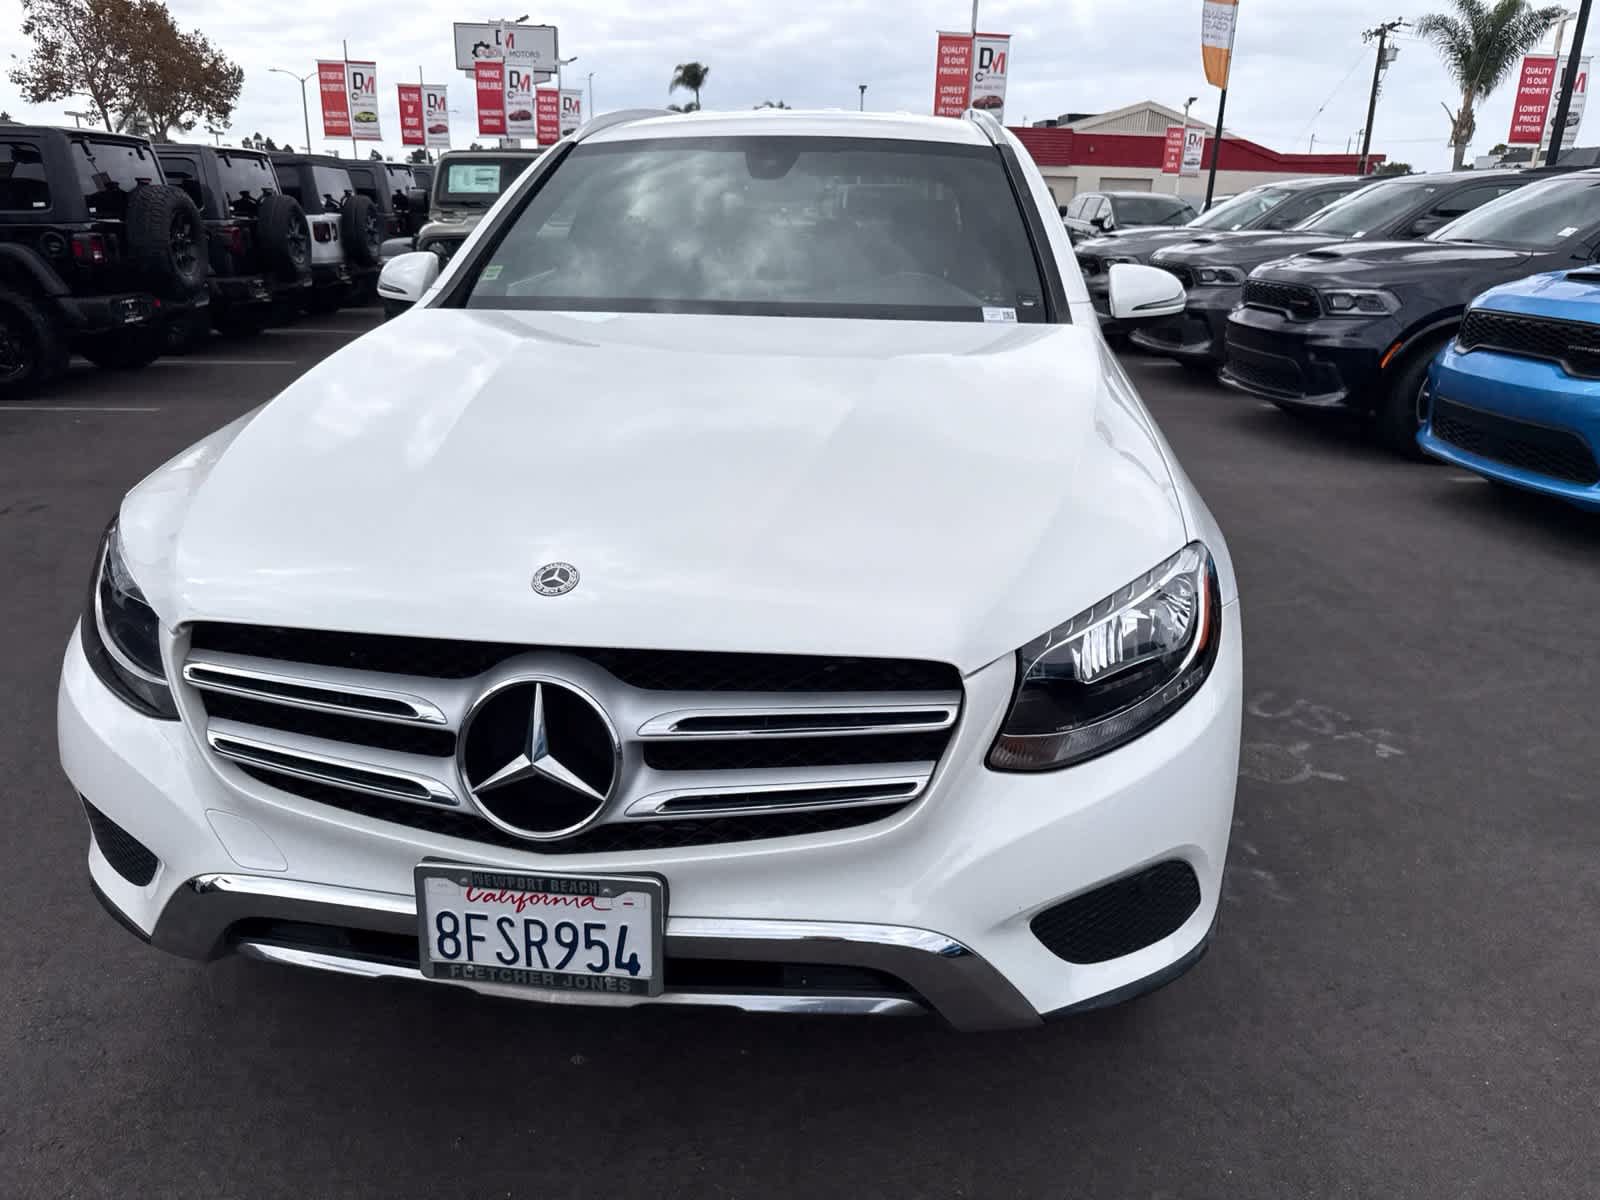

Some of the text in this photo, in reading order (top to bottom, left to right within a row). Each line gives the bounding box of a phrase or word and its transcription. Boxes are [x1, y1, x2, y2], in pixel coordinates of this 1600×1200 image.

[509, 50, 540, 58] MOTORS
[941, 46, 968, 55] QUALITY
[944, 57, 965, 65] IS OUR
[938, 67, 968, 76] PRIORITY
[1525, 66, 1552, 75] QUALITY
[1526, 77, 1548, 85] IS OUR
[940, 86, 965, 94] LOWEST
[1520, 87, 1550, 95] PRIORITY
[941, 96, 962, 105] PRICES
[1519, 105, 1545, 113] LOWEST
[1519, 115, 1541, 123] PRICES
[1514, 125, 1521, 133] IN
[471, 872, 599, 894] NEWPORT BEACH
[466, 885, 612, 913] California
[435, 911, 641, 976] 8FSR954
[562, 976, 632, 993] JONES
